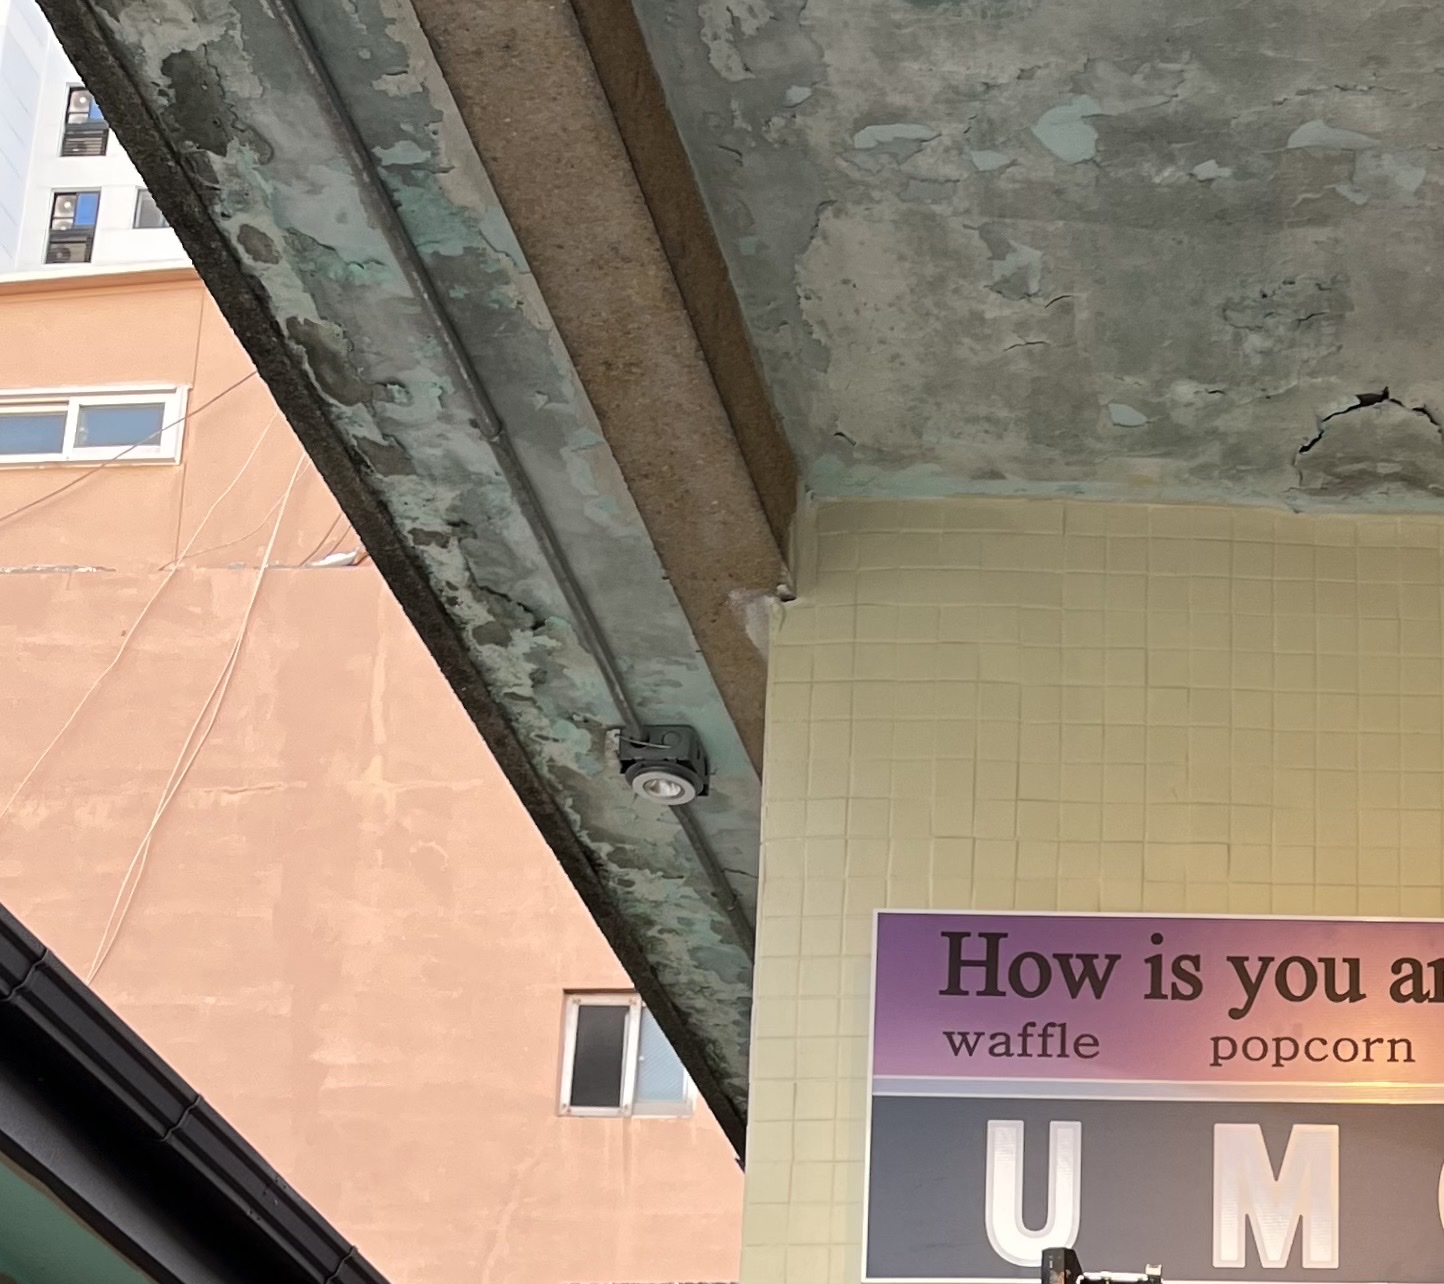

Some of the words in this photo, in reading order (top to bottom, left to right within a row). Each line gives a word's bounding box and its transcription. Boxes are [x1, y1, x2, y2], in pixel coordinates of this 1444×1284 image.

[938, 930, 1122, 1000] How
[1143, 932, 1204, 1001] is
[1225, 954, 1367, 1021] you
[942, 1021, 1101, 1059] waffle
[1209, 1034, 1416, 1068] popcorn
